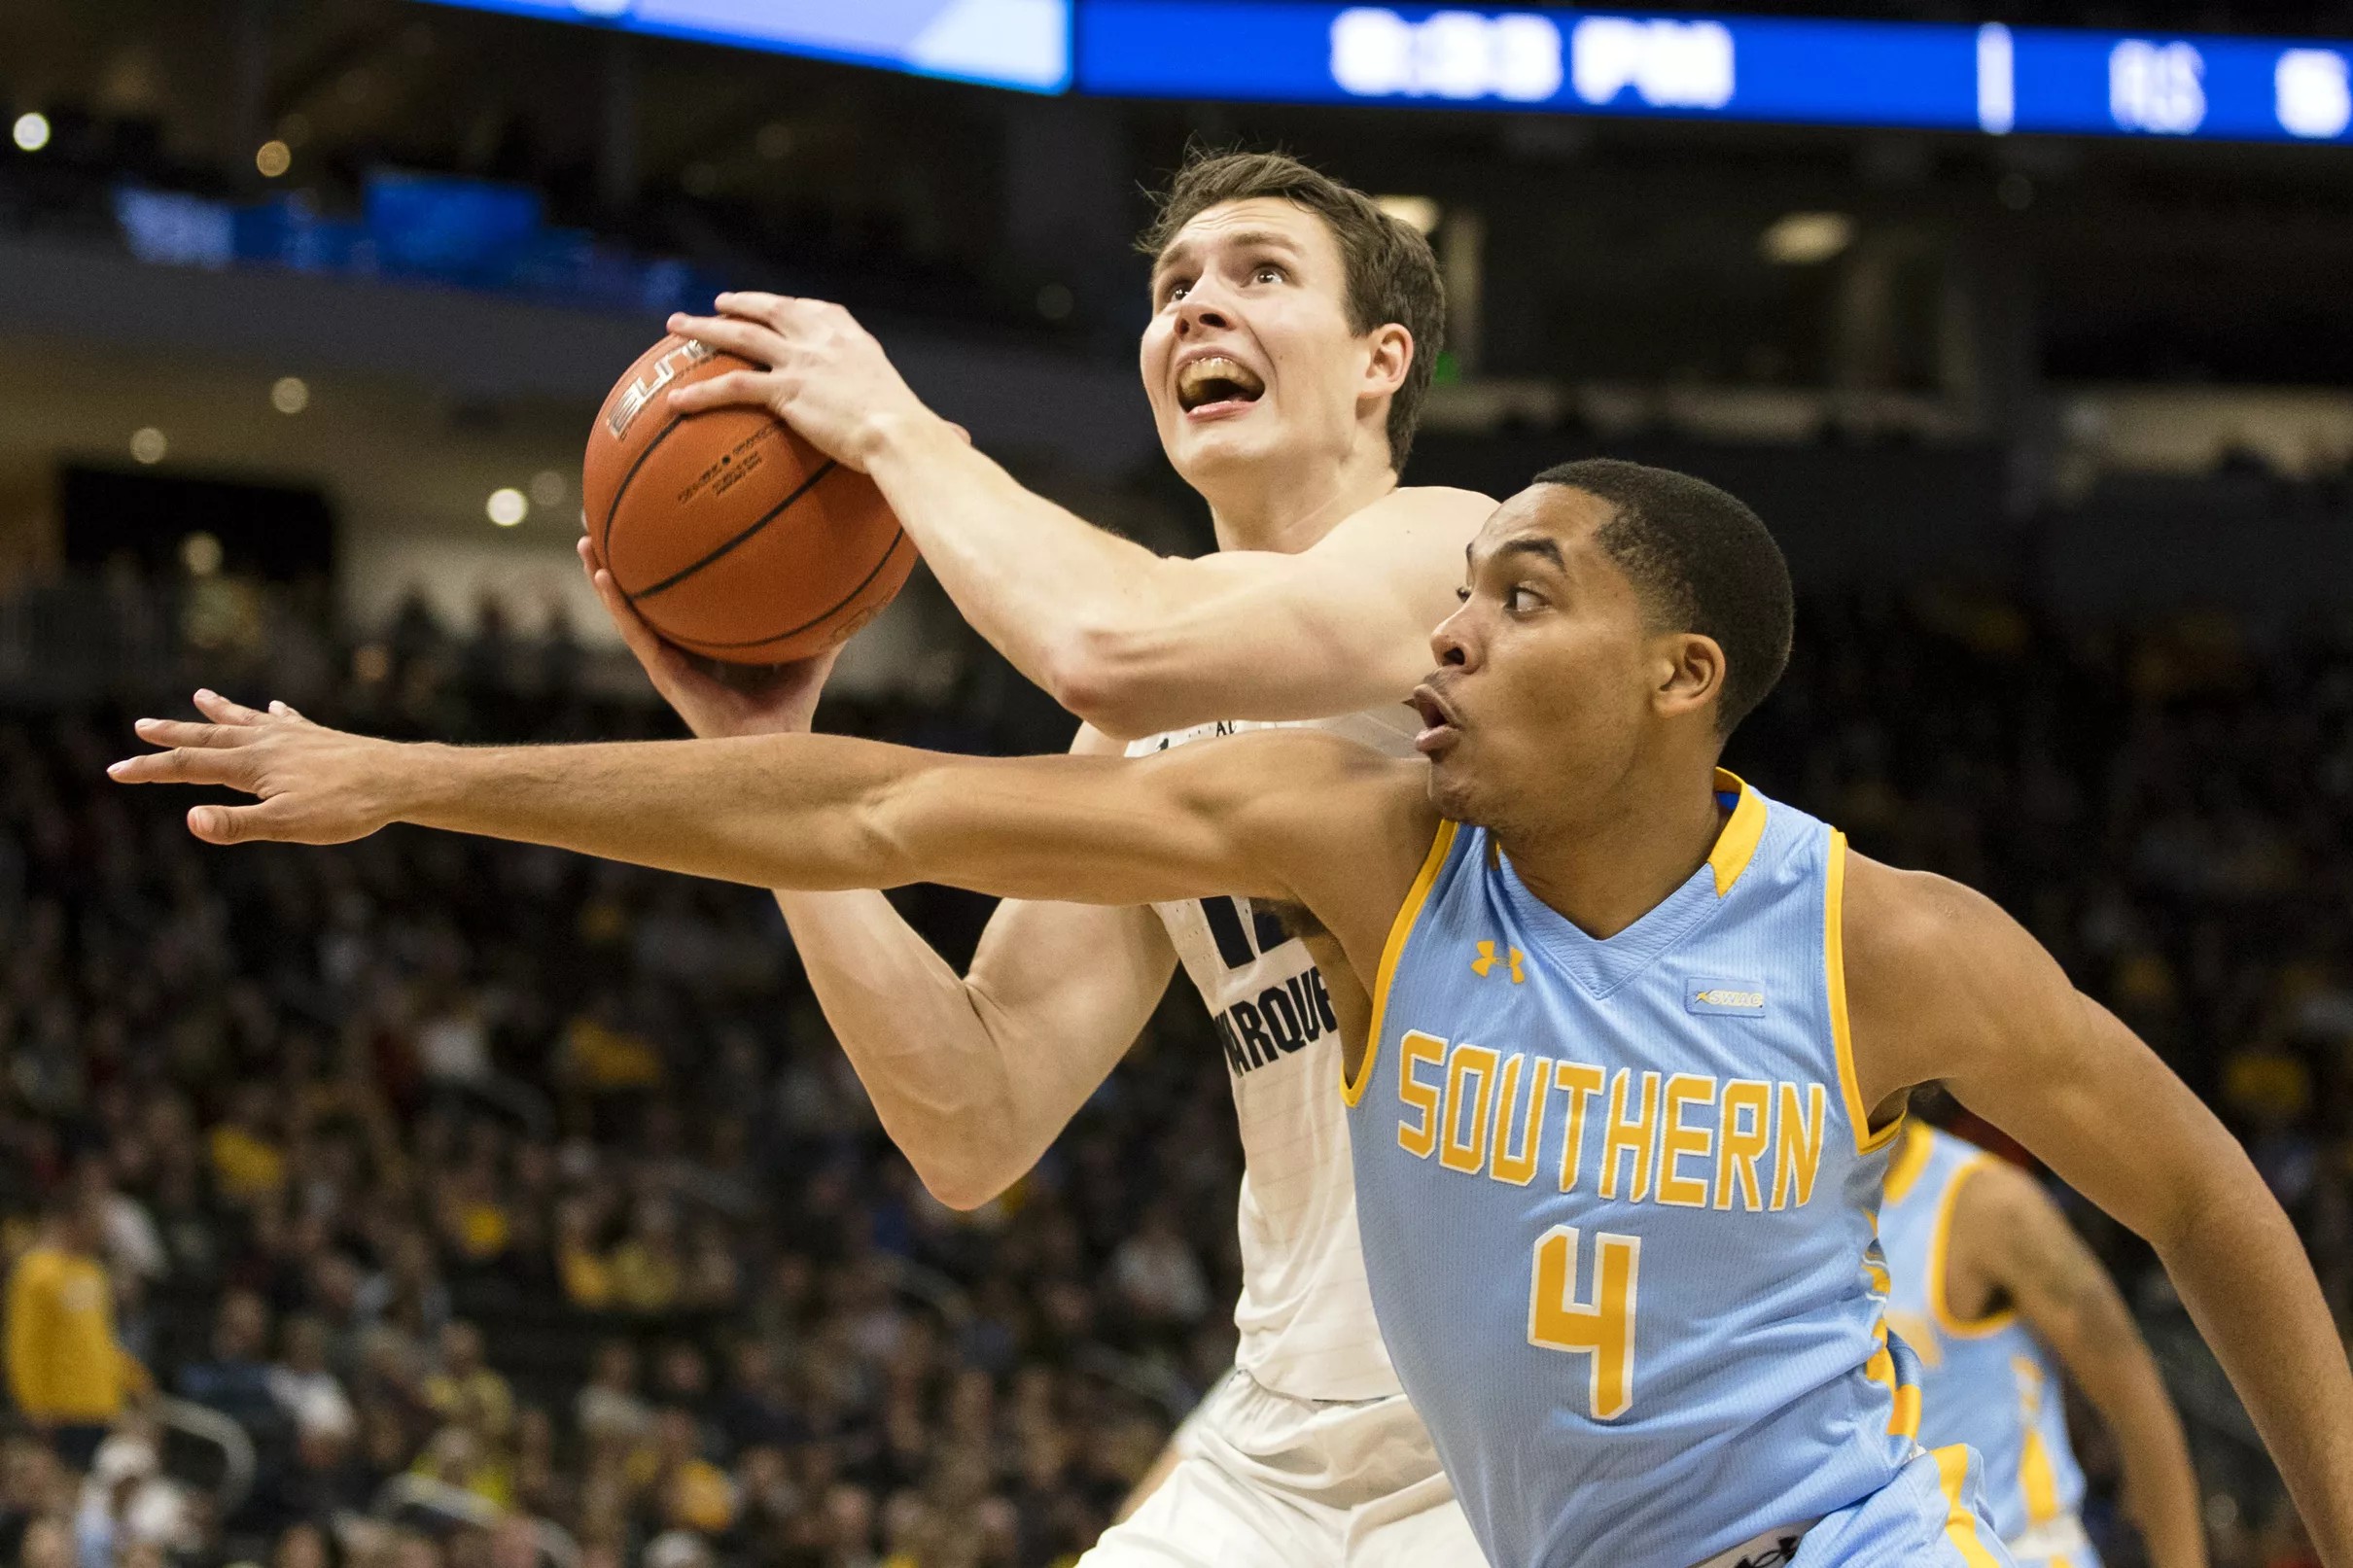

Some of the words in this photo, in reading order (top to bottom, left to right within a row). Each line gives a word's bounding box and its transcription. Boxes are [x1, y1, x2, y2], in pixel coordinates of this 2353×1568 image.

[1215, 966, 1338, 1079] ARQUE
[1397, 1028, 1826, 1212] SOUTHERN
[1528, 1224, 1641, 1420] 4
